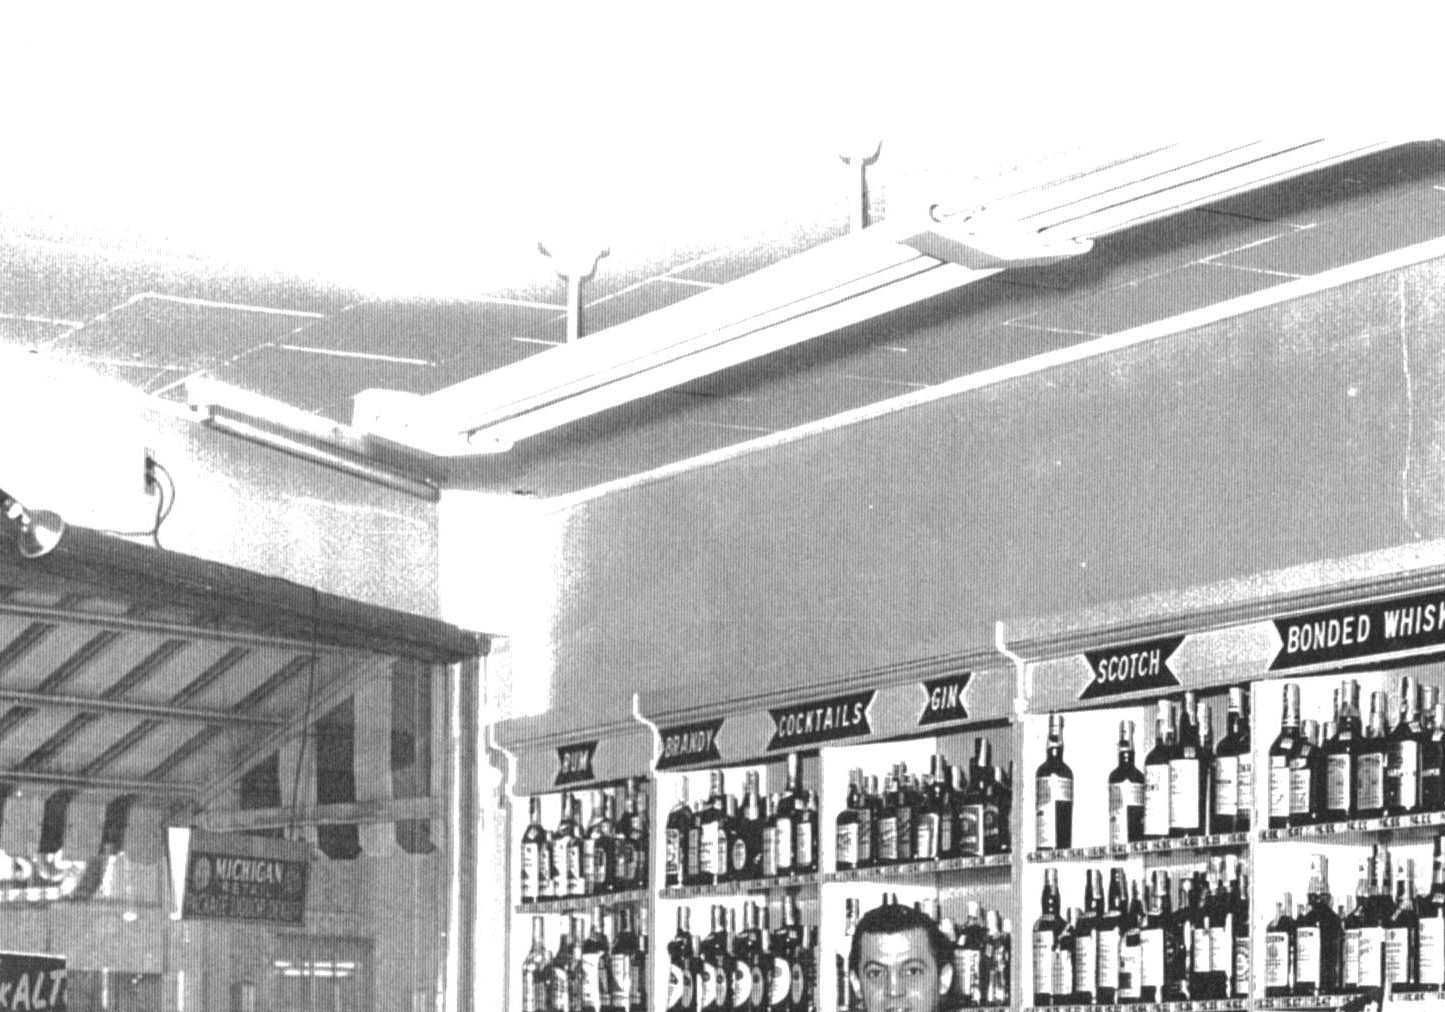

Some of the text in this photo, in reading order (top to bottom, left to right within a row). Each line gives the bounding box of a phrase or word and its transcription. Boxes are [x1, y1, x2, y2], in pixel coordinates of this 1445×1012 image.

[1286, 615, 1371, 653] BONDED
[1097, 649, 1162, 684] SCOTCH
[930, 683, 960, 711] GIN
[778, 701, 865, 738] COCKTAILS
[663, 726, 716, 758] BRANDY
[560, 747, 590, 778] RUM
[216, 858, 282, 884] MICHIGAN
